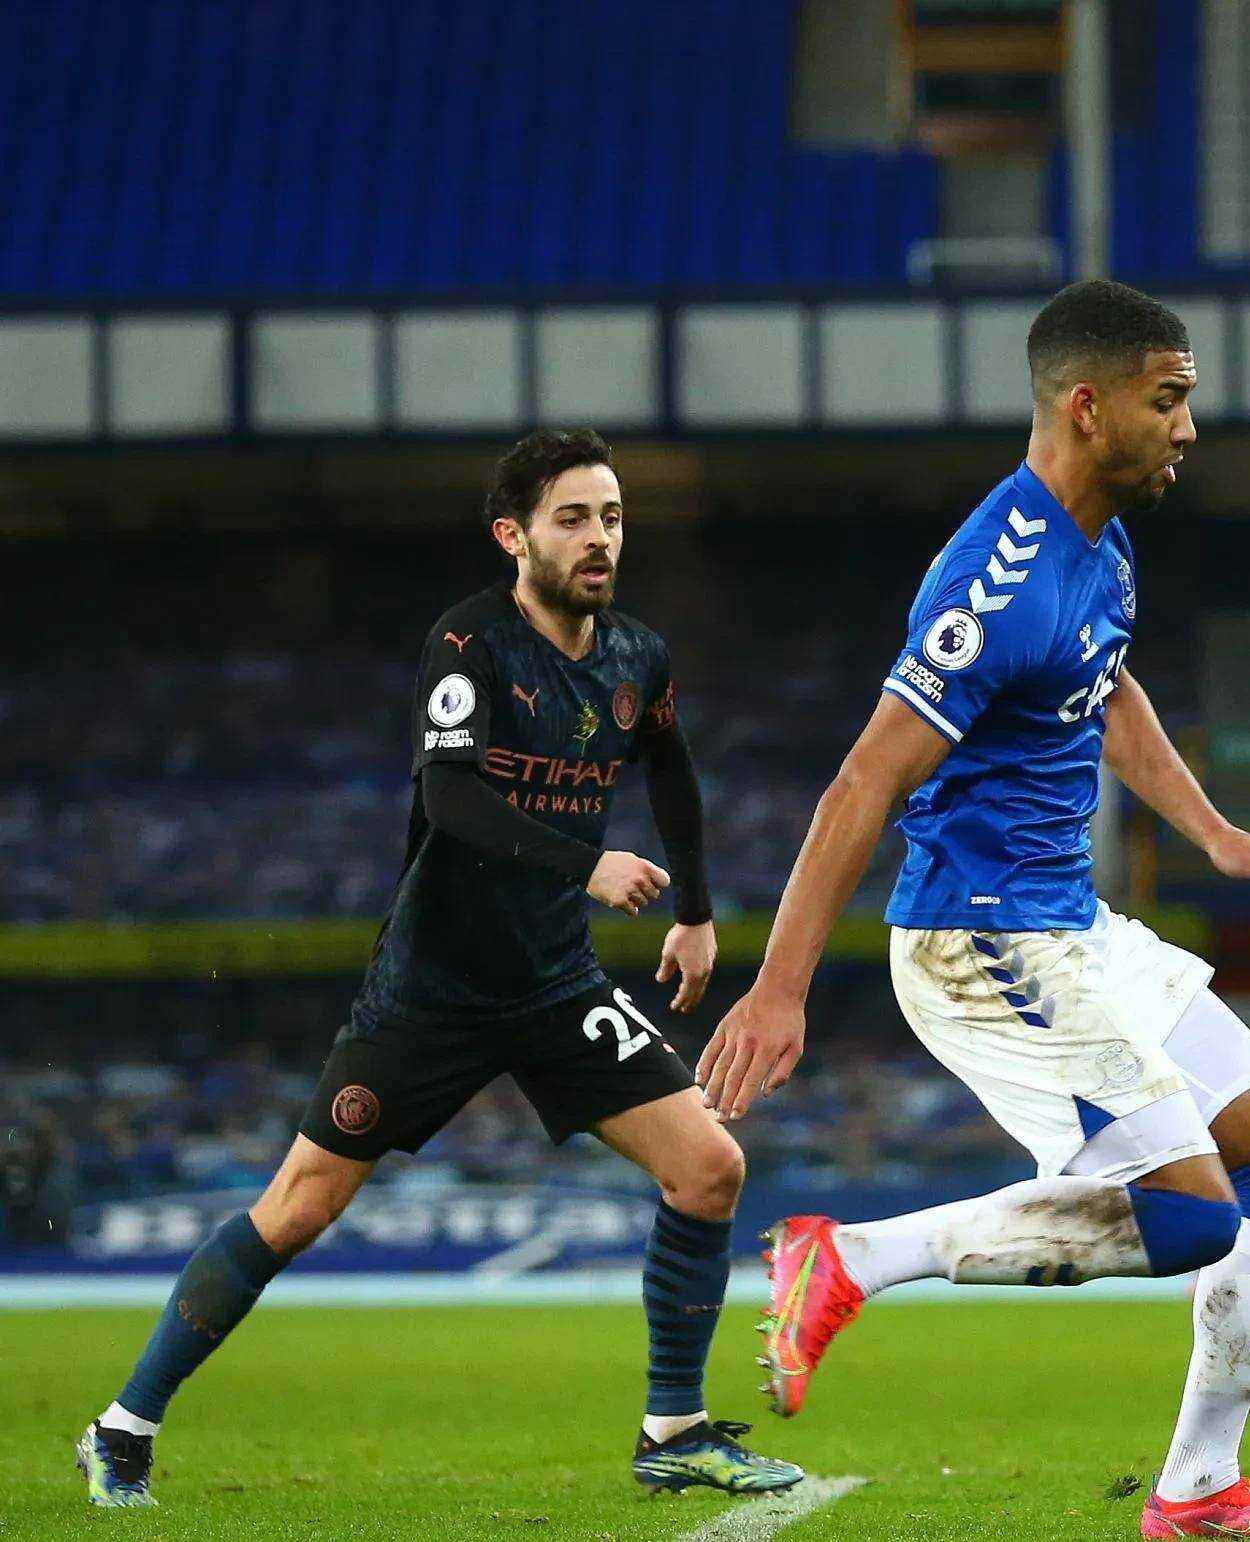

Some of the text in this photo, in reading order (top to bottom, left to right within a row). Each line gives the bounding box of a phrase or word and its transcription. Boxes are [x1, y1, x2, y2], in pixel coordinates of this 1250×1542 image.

[904, 655, 918, 671] No
[914, 665, 944, 691] room
[440, 730, 470, 740] room
[507, 789, 604, 815] AIRWAYS
